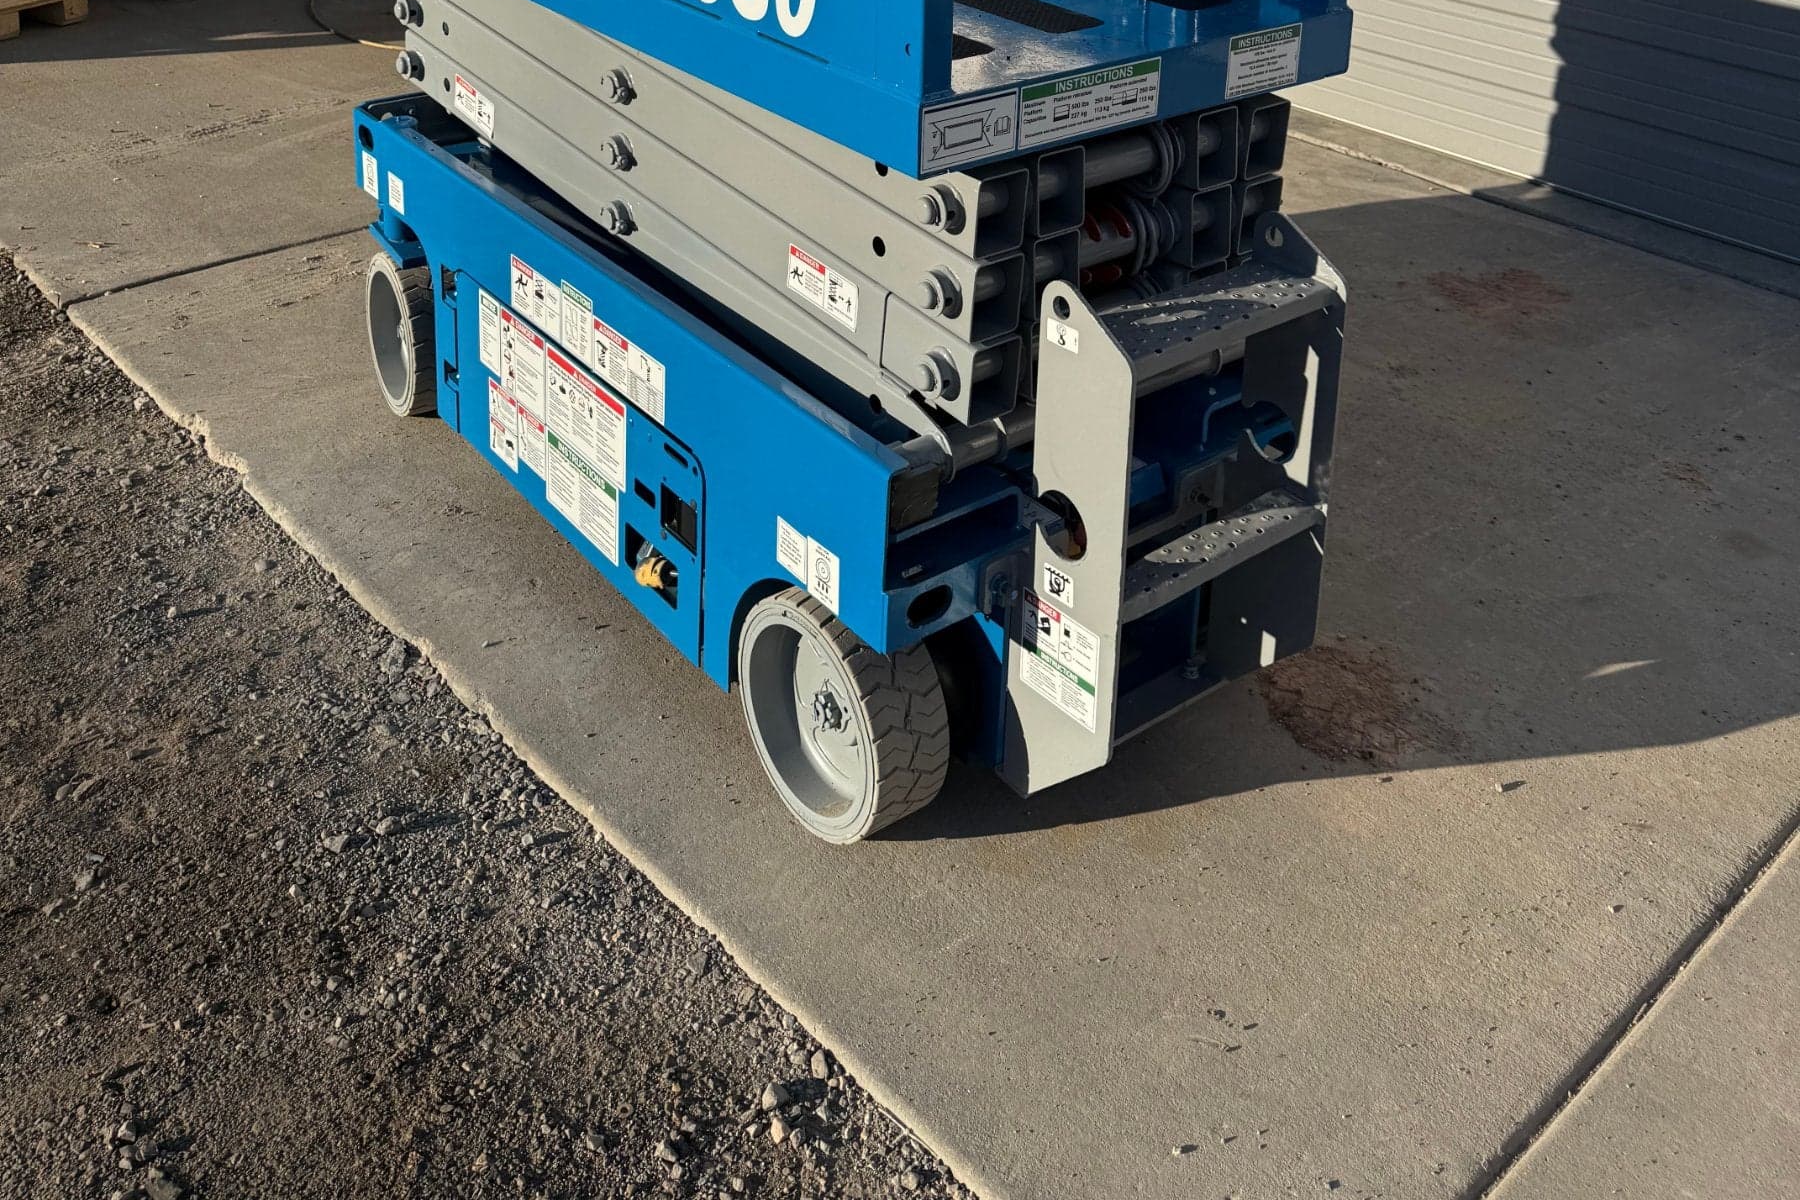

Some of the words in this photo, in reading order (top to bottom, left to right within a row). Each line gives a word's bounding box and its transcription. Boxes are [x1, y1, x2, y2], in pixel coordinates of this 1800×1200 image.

[1238, 29, 1293, 48] INSTRUCTIONS
[1055, 66, 1134, 93] INSTRUCTIONS
[557, 440, 606, 490] INSTRUCTIONS
